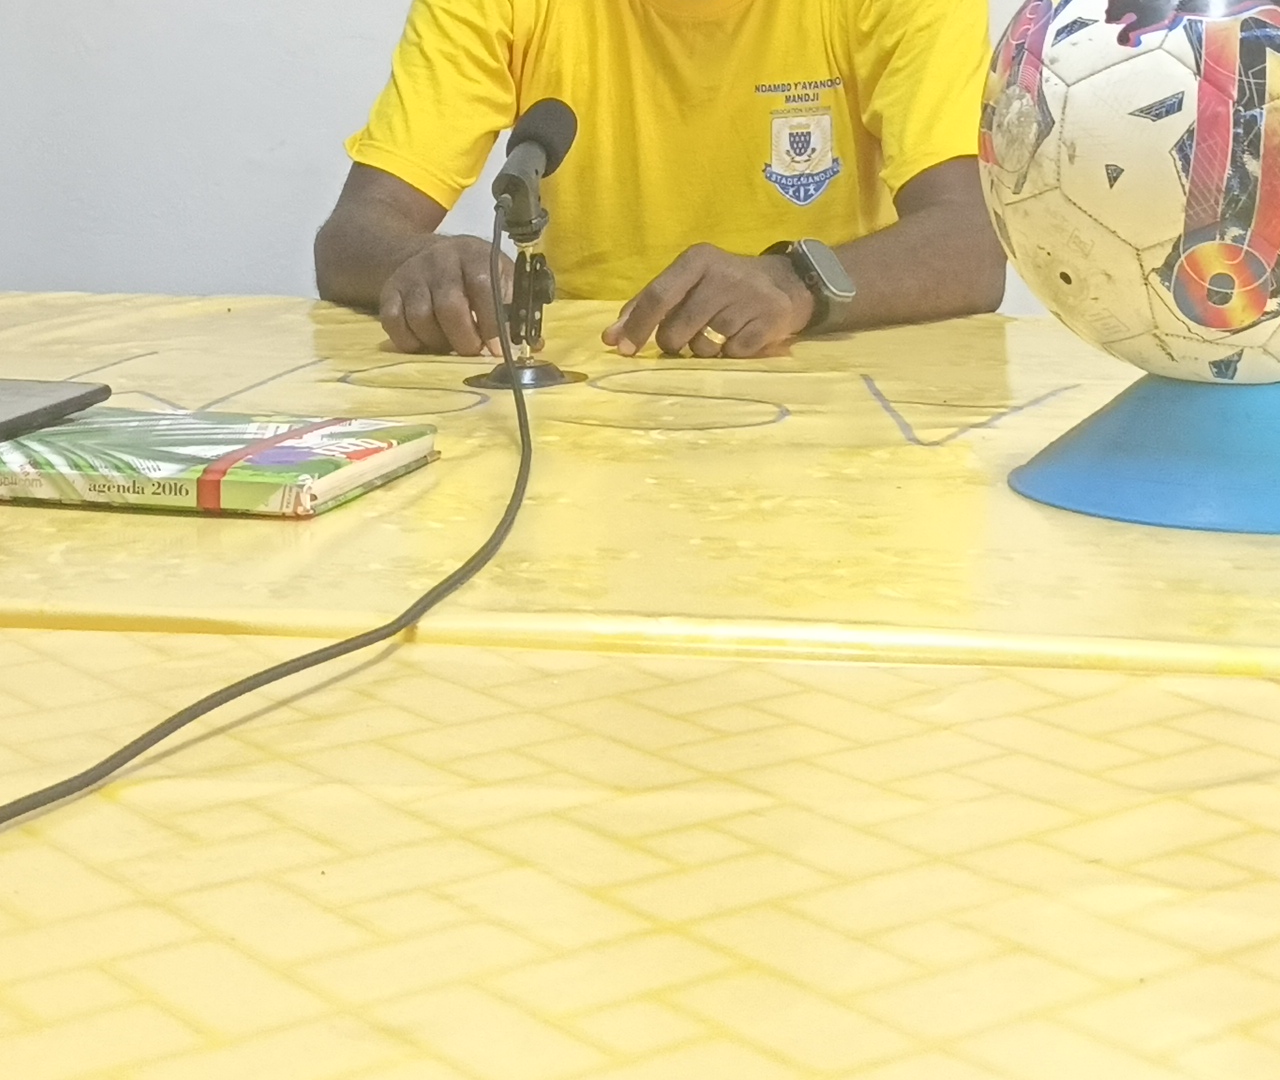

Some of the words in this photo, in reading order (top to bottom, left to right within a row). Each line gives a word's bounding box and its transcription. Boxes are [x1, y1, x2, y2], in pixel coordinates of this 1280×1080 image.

[785, 93, 819, 104] MANDJI
[770, 173, 799, 186] STADE
[800, 170, 834, 185] MANDJI
[88, 480, 146, 496] agenda
[151, 481, 190, 497] 2016
